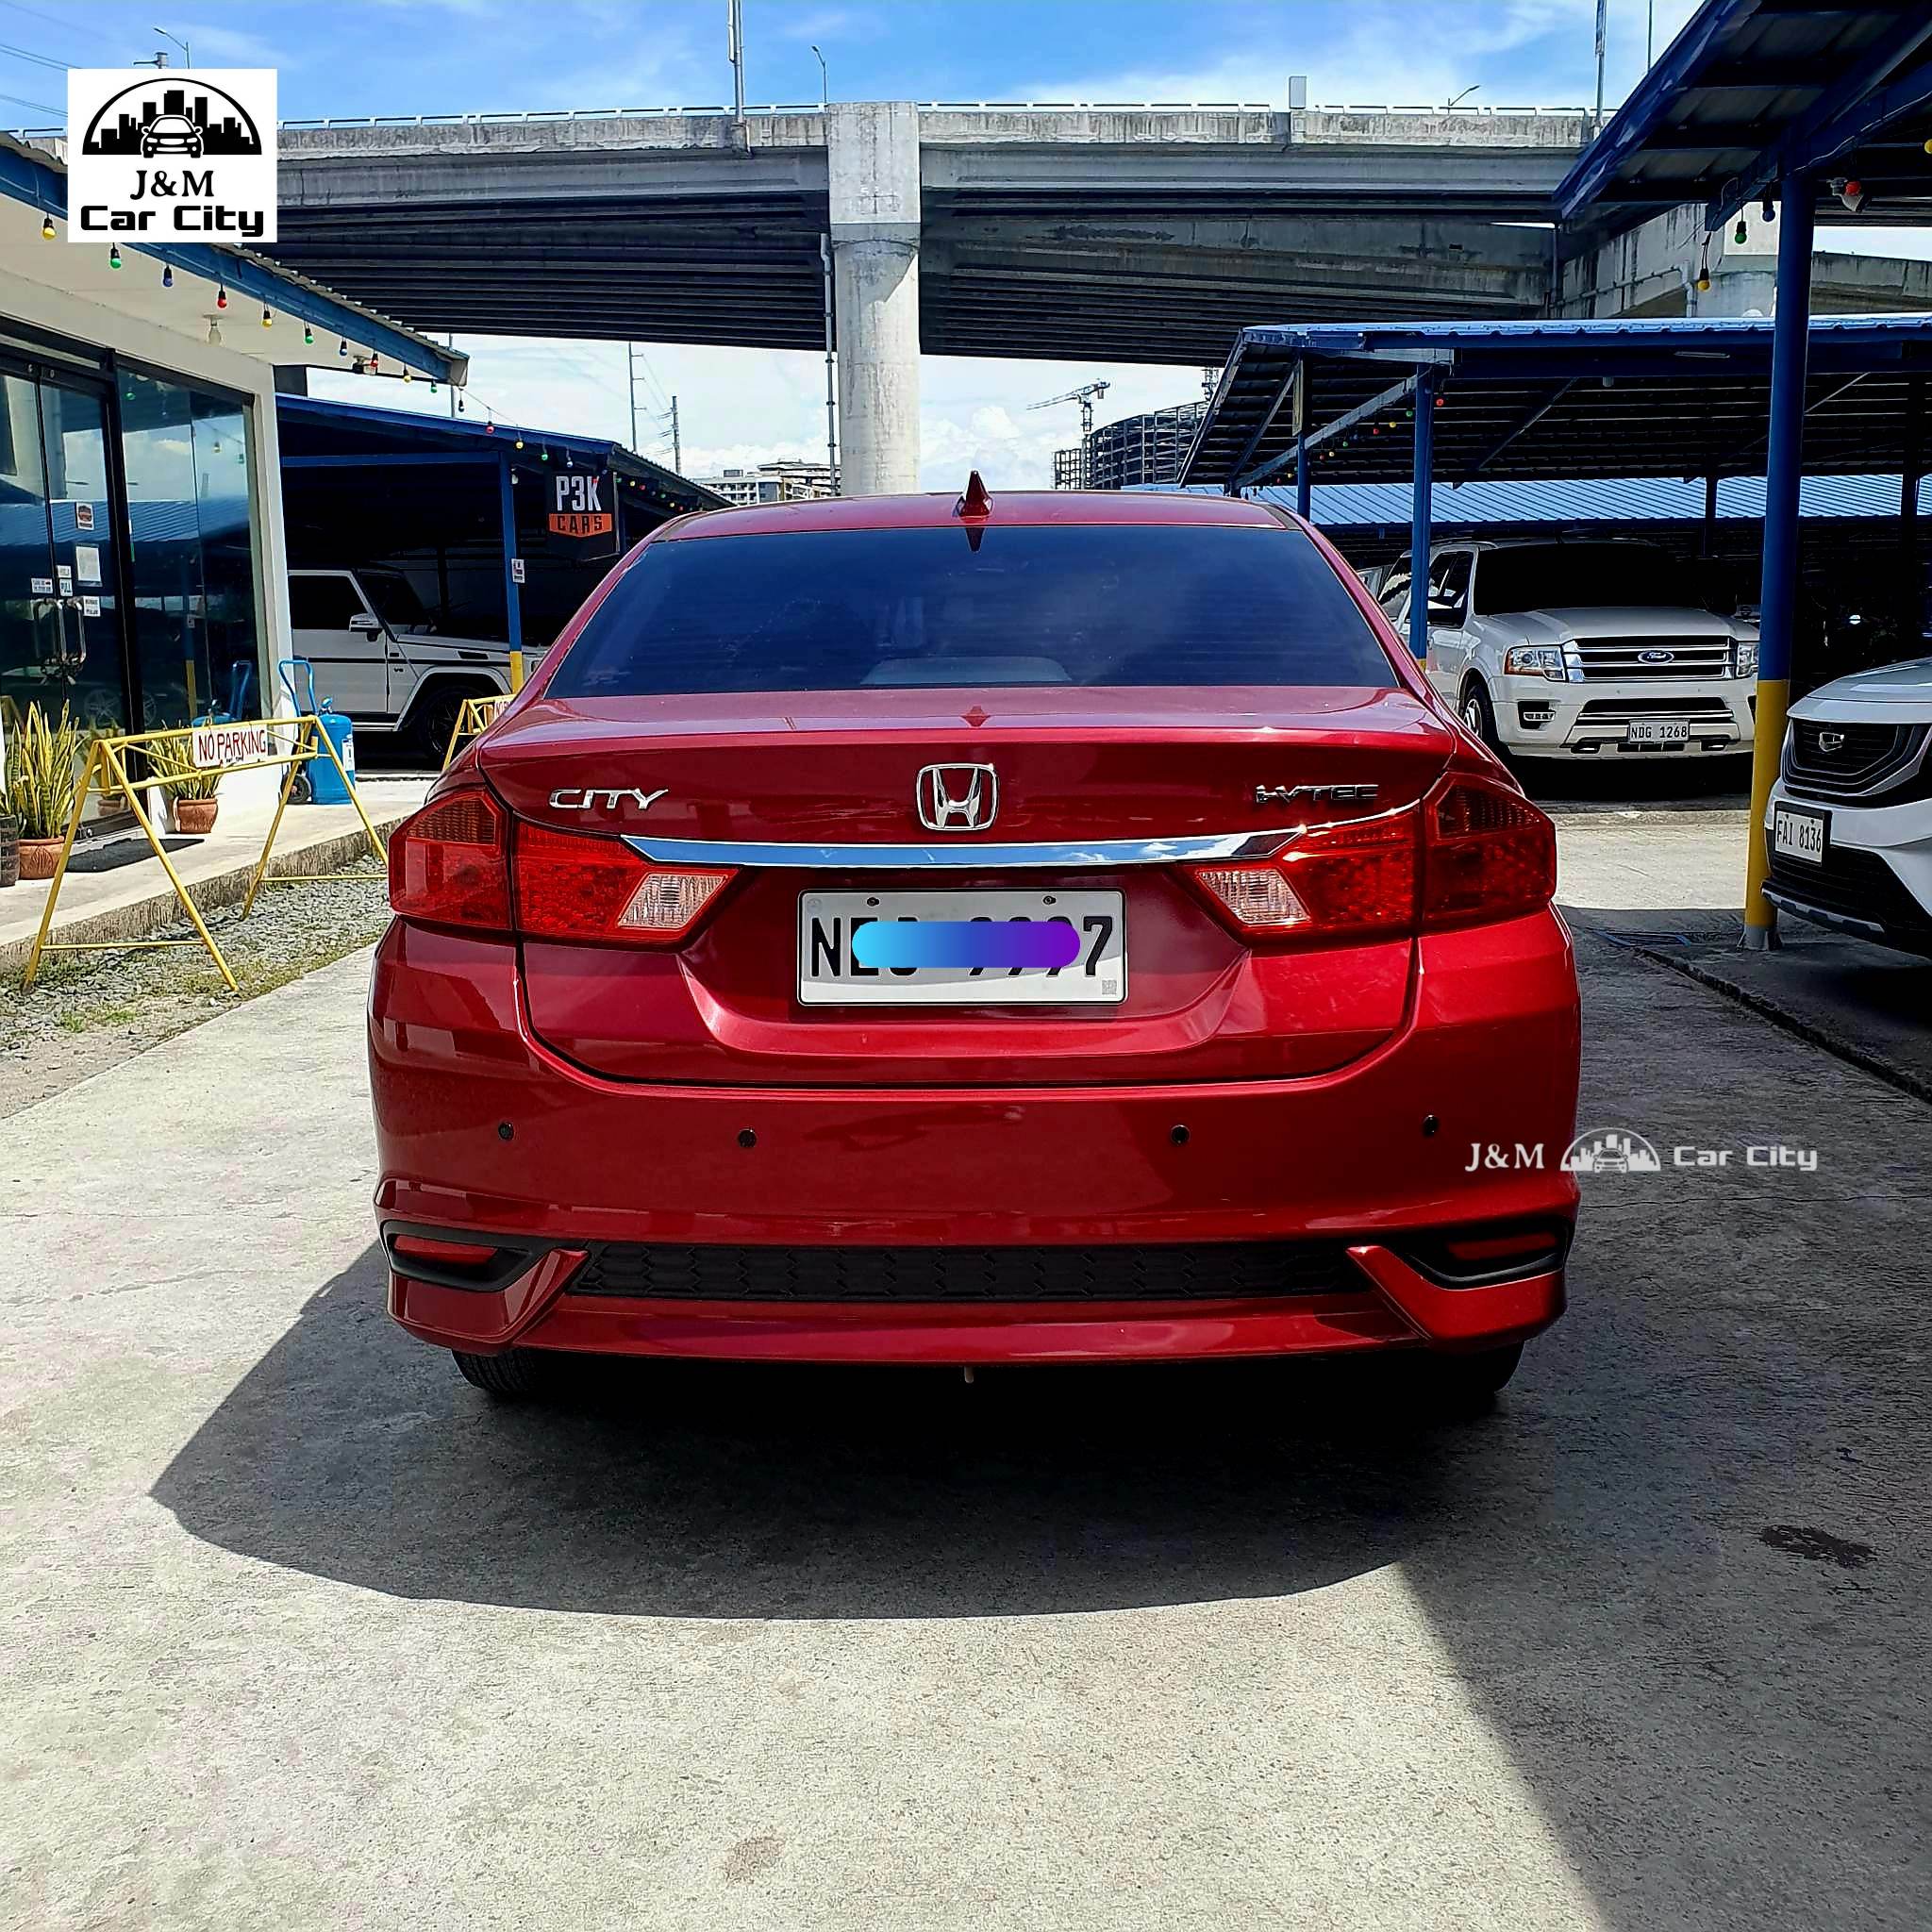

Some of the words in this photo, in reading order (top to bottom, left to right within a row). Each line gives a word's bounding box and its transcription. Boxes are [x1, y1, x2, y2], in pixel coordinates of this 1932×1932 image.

[556, 475, 602, 511] P3K
[557, 515, 603, 533] CARS
[199, 734, 215, 762] NO
[217, 729, 267, 762] PARKING
[1631, 725, 1652, 739] NDG
[1659, 725, 1688, 739] 1268
[549, 788, 669, 809] CITY
[1777, 820, 1793, 846] FAI
[1799, 824, 1822, 853] 8136
